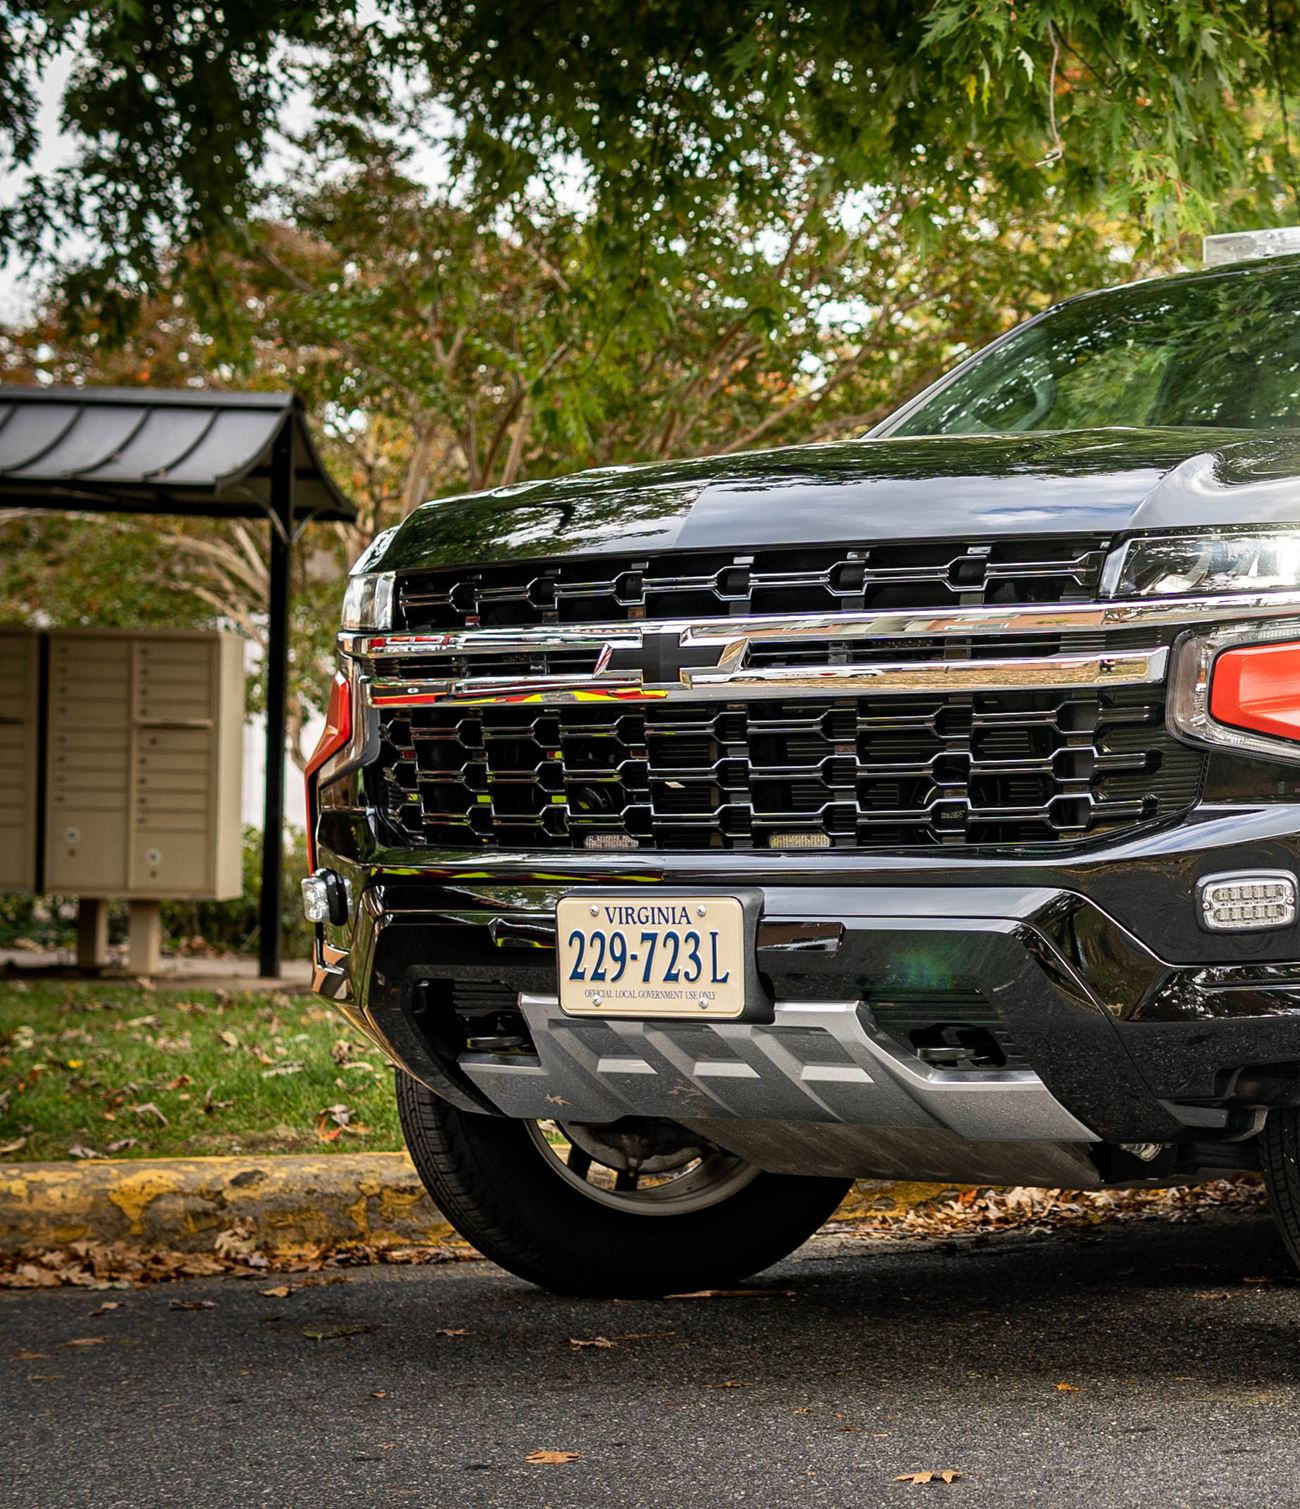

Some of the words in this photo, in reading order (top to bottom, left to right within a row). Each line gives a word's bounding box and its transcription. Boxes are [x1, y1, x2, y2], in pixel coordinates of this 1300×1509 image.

[604, 906, 692, 925] VIRGINIA
[615, 989, 637, 999] LOCAL
[638, 990, 683, 1000] GOVERNMENT
[685, 990, 698, 1000] USE
[698, 991, 716, 1000] ONLY
